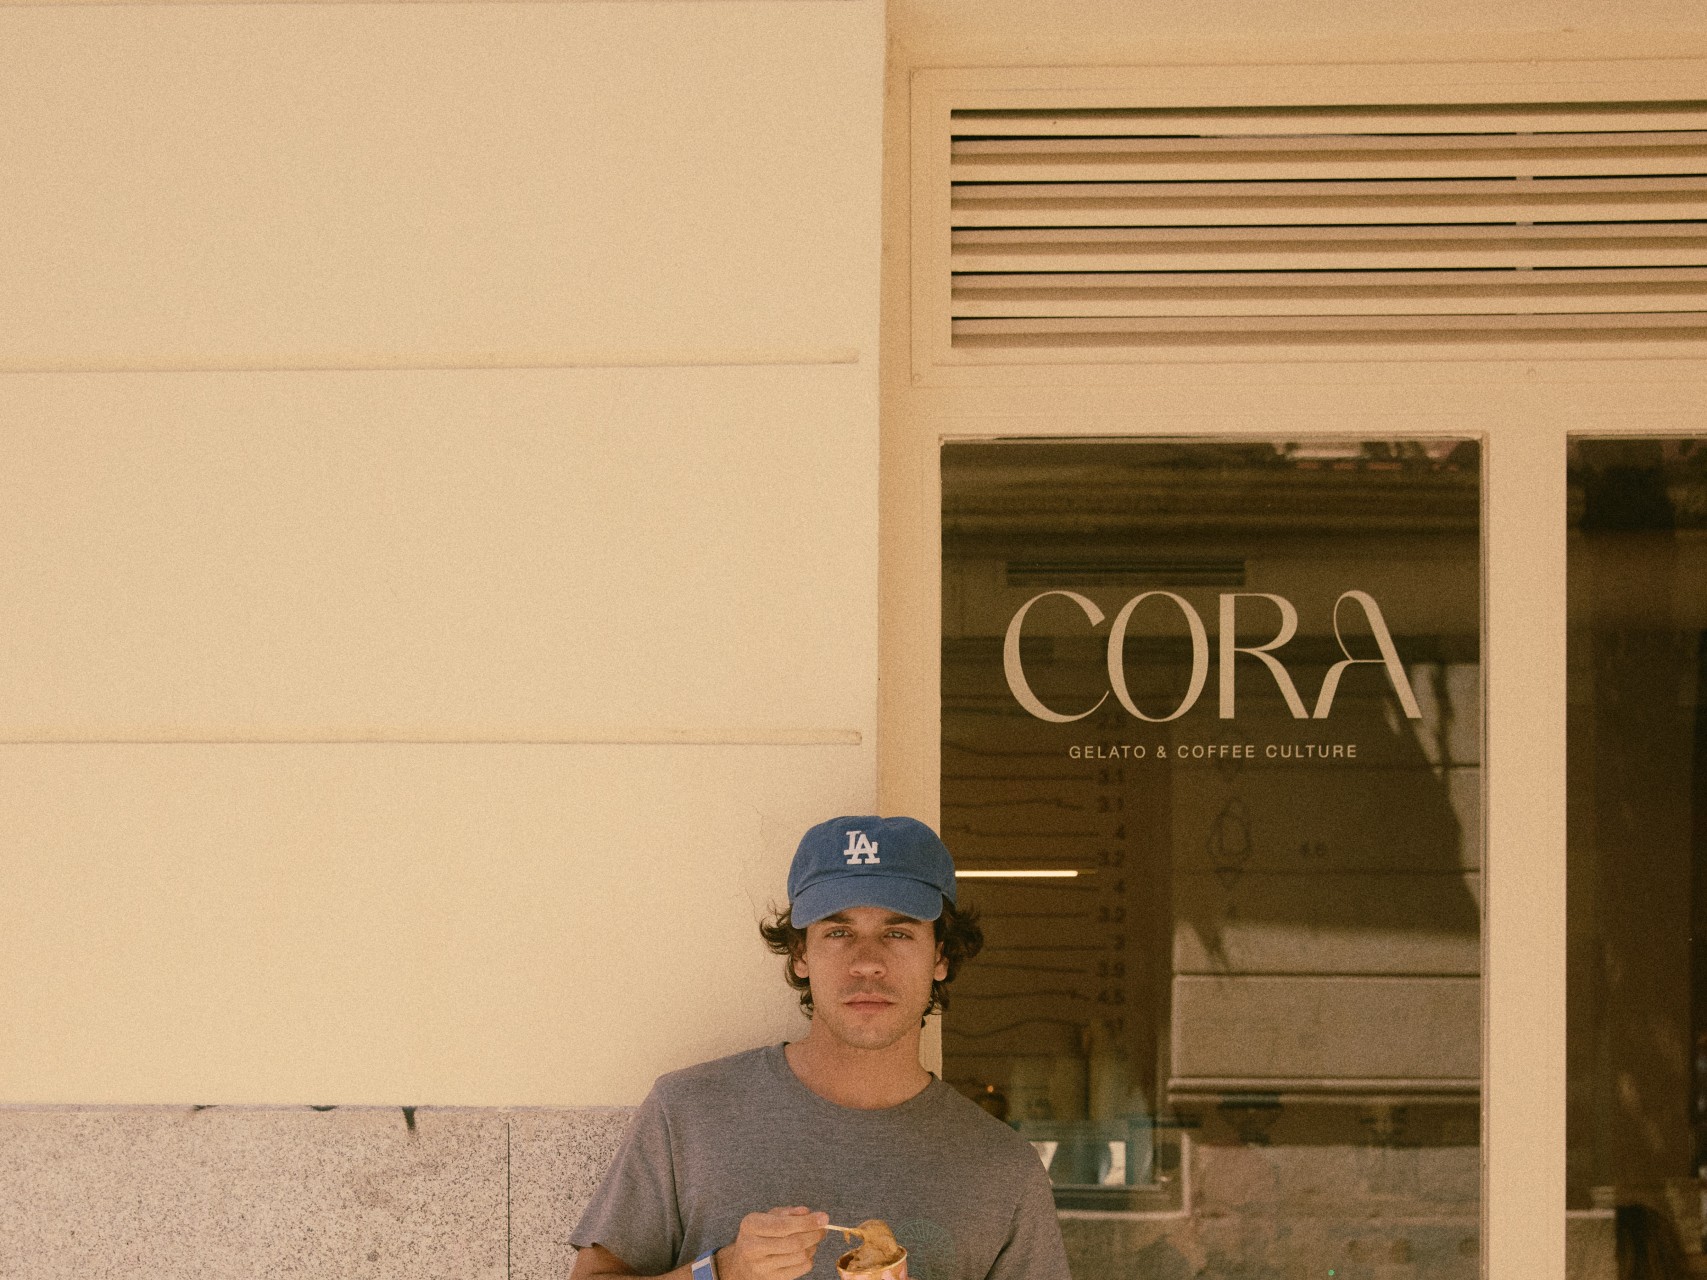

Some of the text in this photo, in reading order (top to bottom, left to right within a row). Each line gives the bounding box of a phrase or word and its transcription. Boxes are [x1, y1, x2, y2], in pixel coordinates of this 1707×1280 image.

[1003, 590, 1422, 722] CORA
[1069, 745, 1357, 759] GELATO & COFFEE CULTURE
[843, 830, 881, 865] LA
